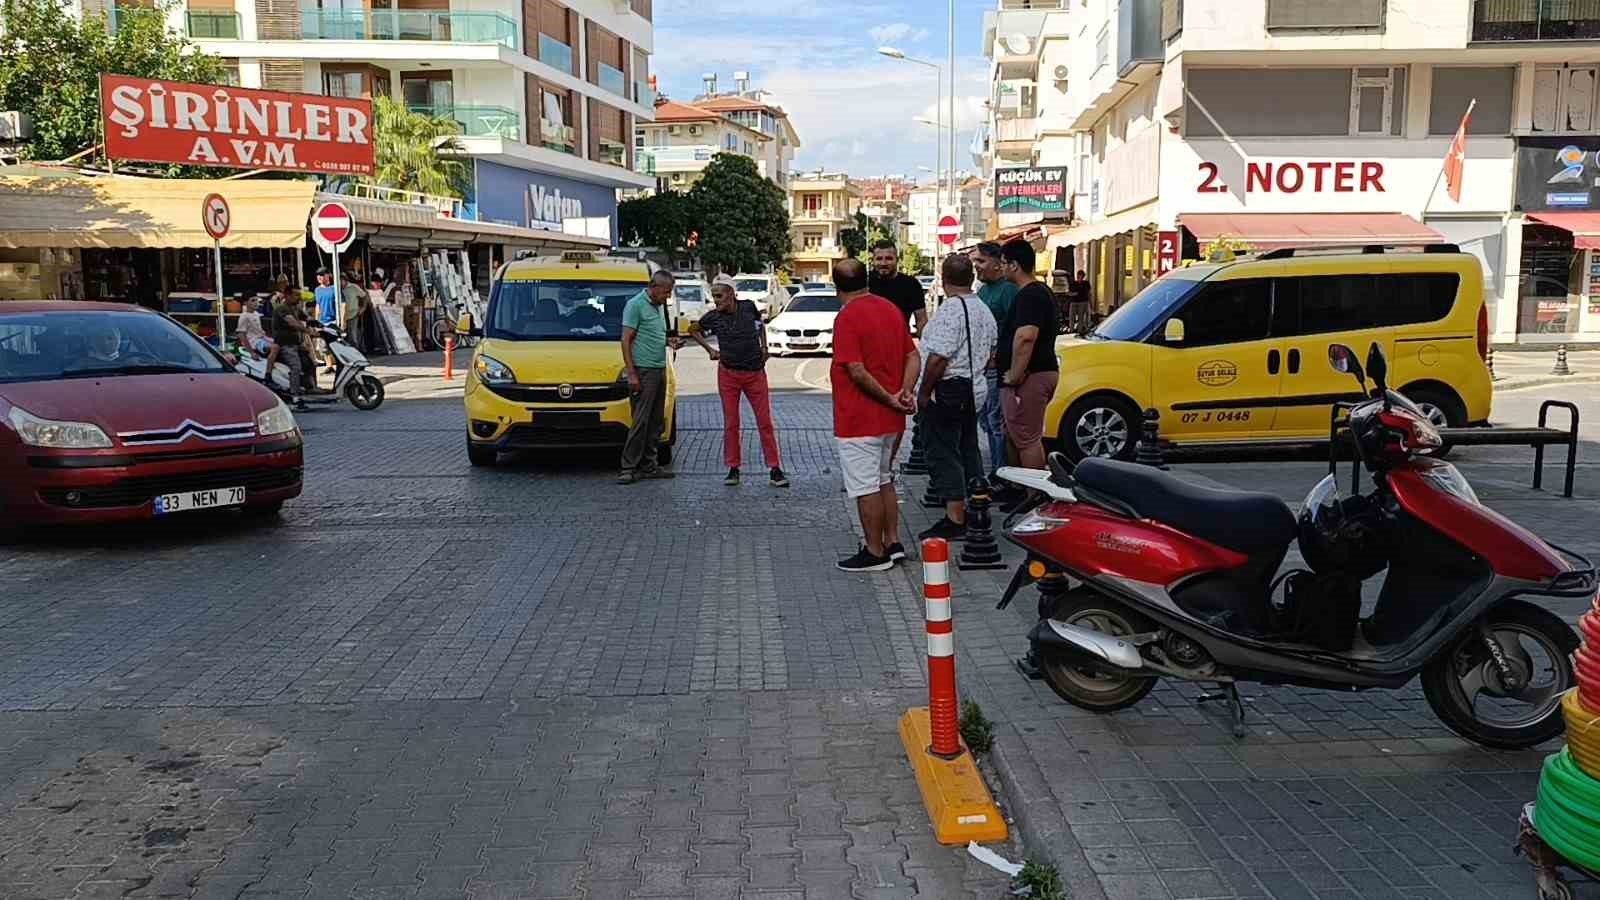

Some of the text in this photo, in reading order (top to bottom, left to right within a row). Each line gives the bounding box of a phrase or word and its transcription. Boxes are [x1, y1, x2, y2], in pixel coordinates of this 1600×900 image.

[109, 83, 369, 145] ŞİRİNLER
[188, 136, 307, 169] A.V.M.
[999, 169, 1062, 184] KÜÇÜK EV
[1197, 162, 1386, 193] 2. NOTER
[998, 186, 1009, 195] EV
[530, 184, 582, 222] Vatan
[1161, 239, 1174, 253] 2
[1181, 410, 1250, 423] 07 J 0448
[162, 495, 180, 510] 33
[192, 490, 218, 507] NEN
[228, 487, 245, 503] 70
